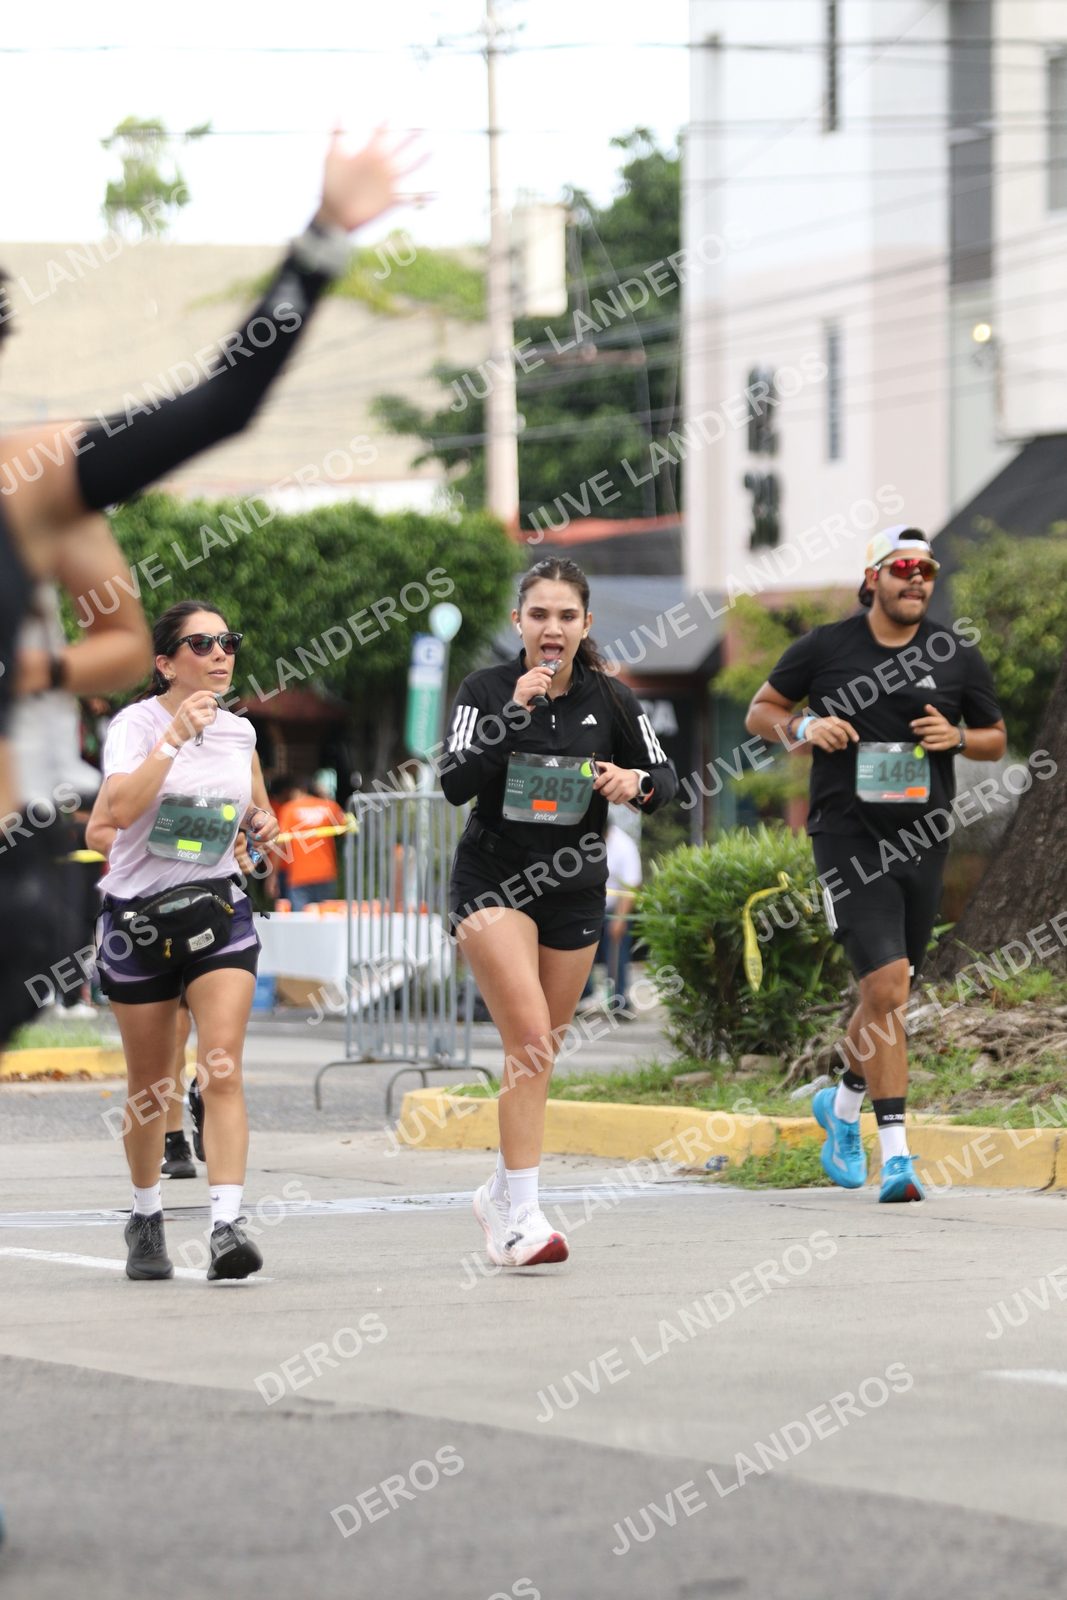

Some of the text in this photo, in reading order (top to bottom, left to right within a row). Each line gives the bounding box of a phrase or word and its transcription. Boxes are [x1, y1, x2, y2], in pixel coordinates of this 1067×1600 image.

[878, 759, 928, 782] 1464
[528, 775, 589, 803] 2857
[174, 815, 233, 843] 2859
